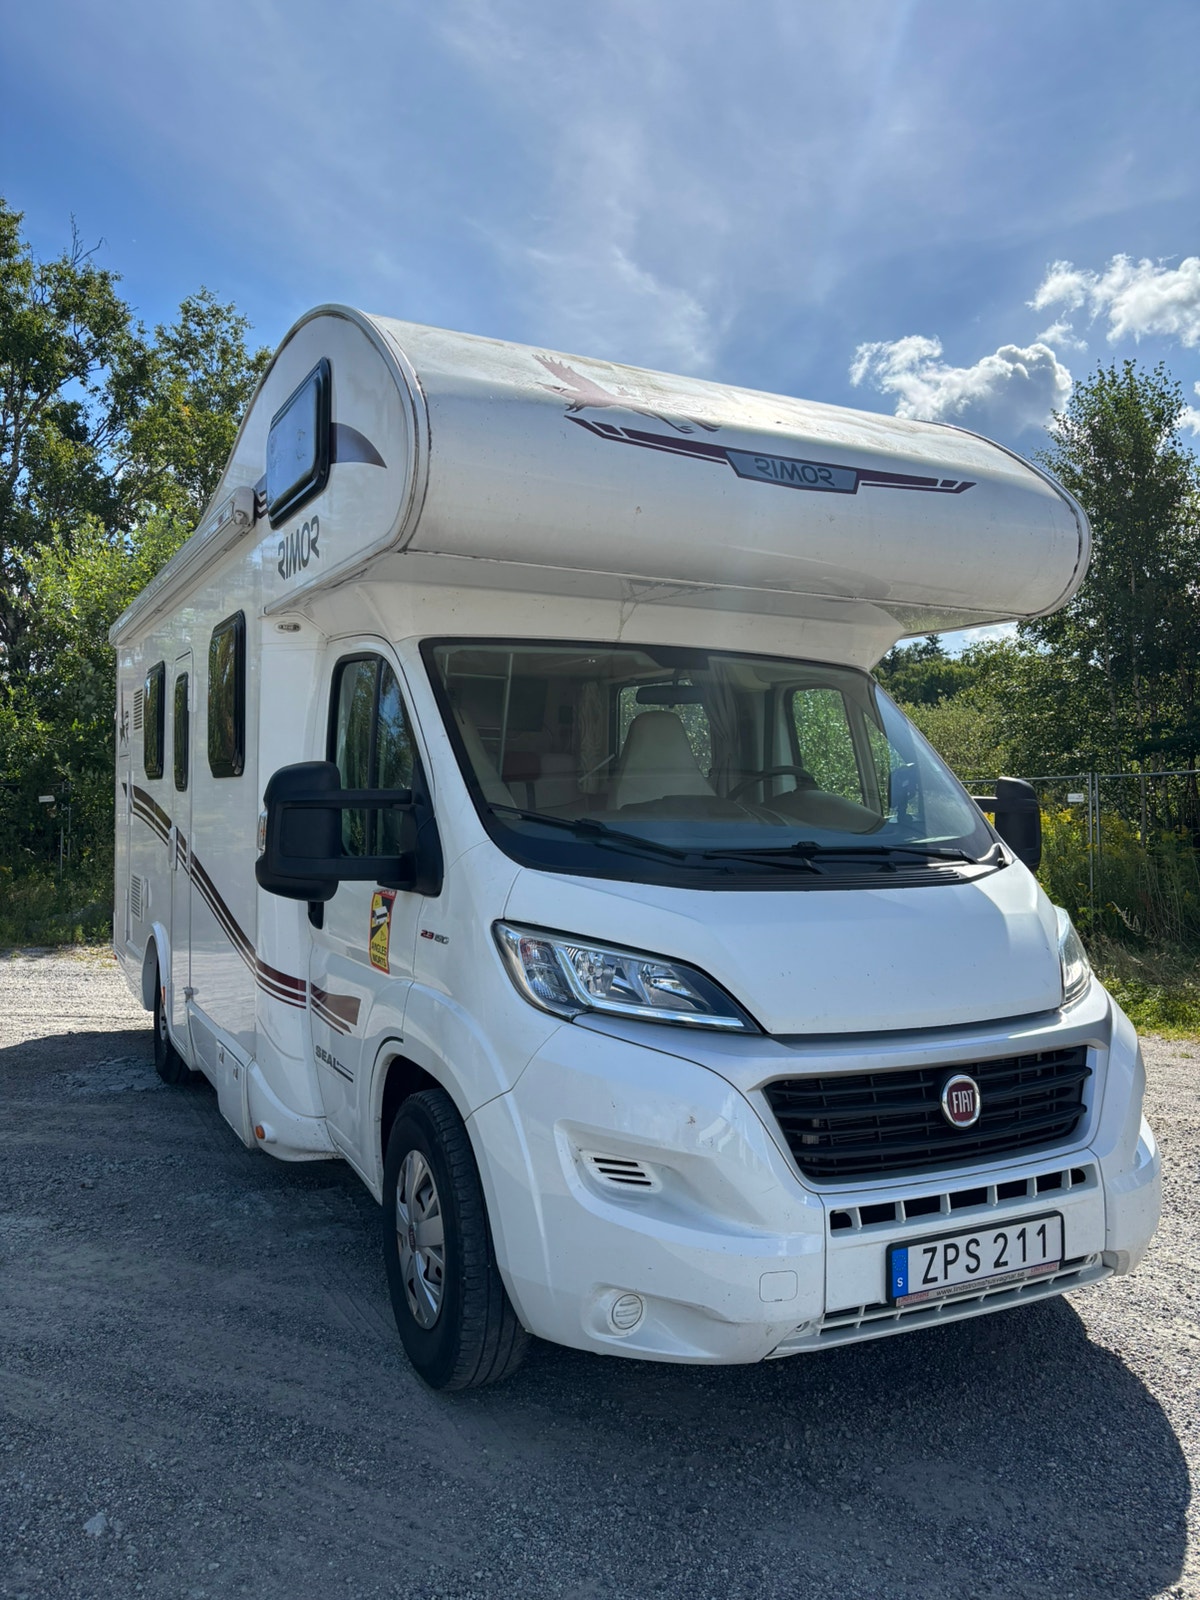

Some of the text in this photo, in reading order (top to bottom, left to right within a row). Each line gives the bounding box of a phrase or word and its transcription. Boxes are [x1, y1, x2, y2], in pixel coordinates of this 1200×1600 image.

[754, 457, 835, 487] RIMOR
[277, 515, 320, 580] RIMOR
[315, 1045, 337, 1069] SEAL
[952, 1089, 974, 1114] FIAT
[922, 1223, 1047, 1285] ZPS 211
[897, 1277, 904, 1287] S
